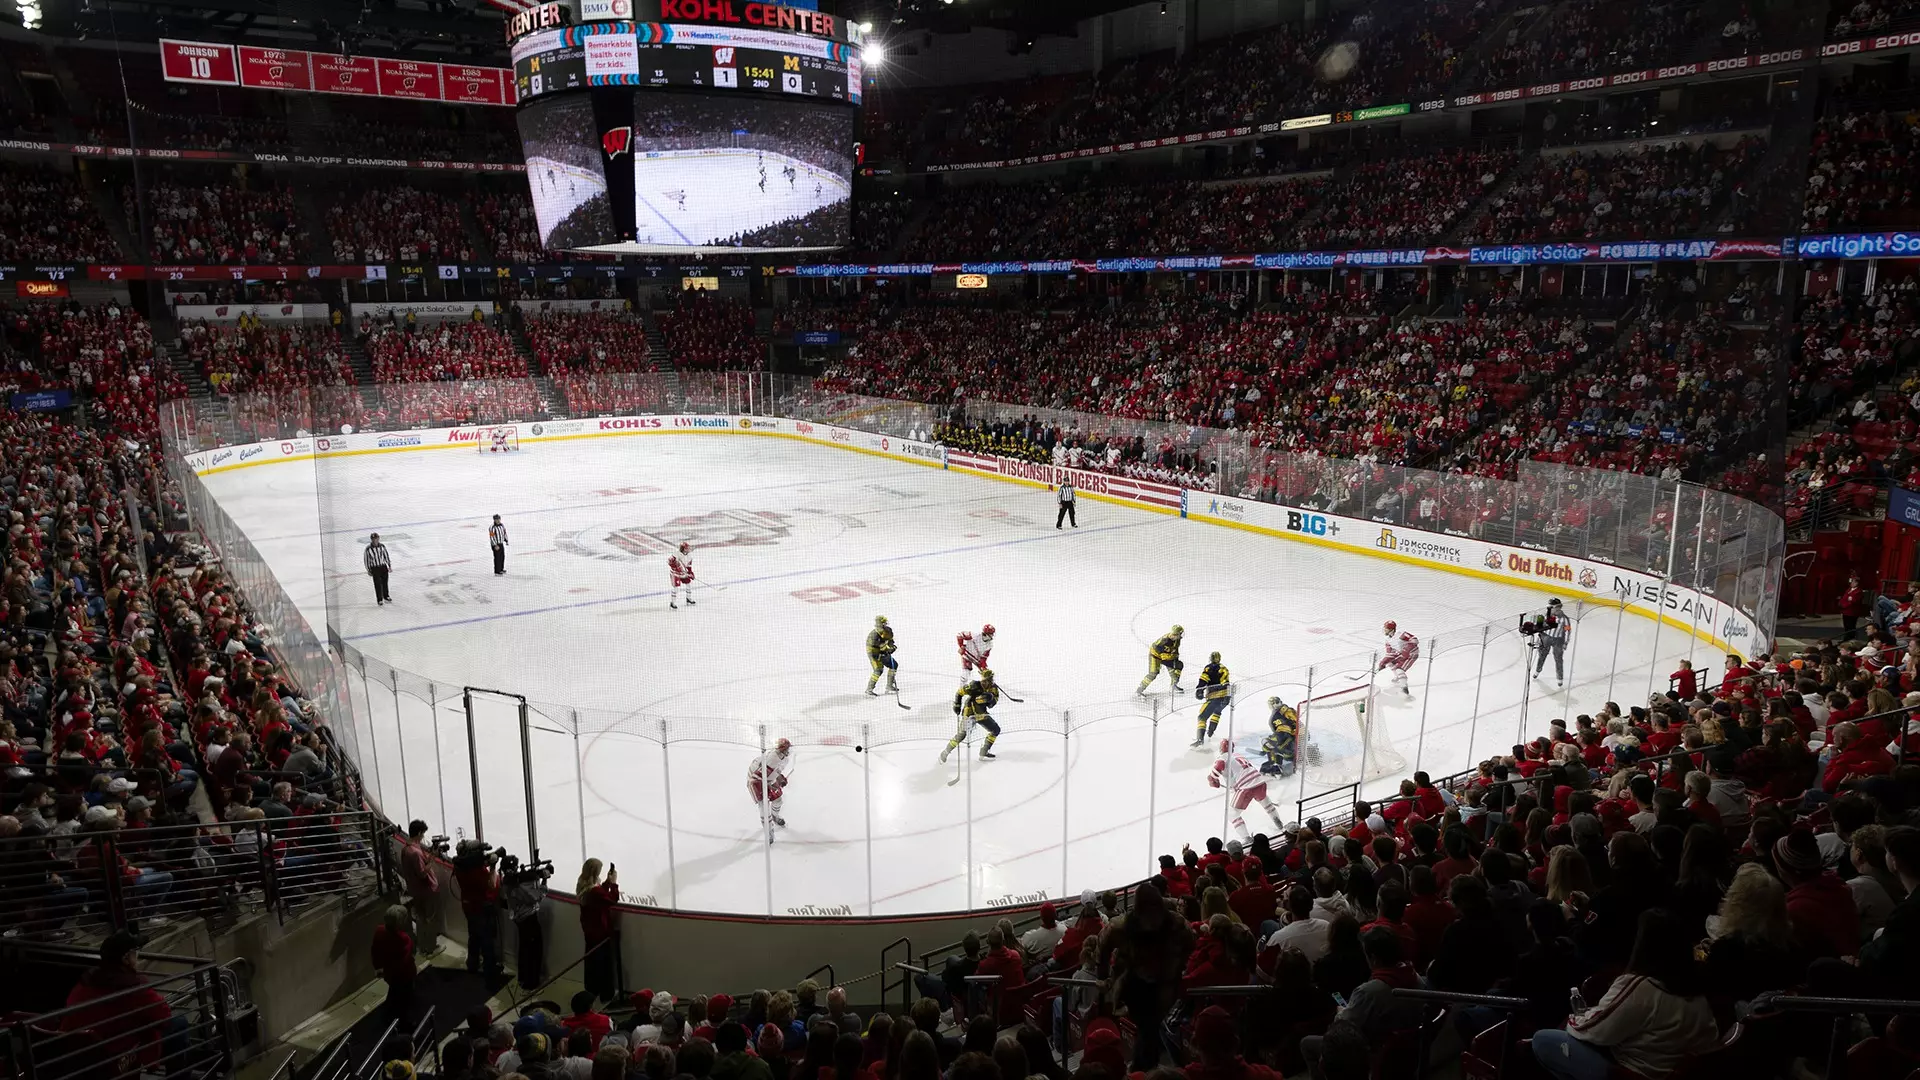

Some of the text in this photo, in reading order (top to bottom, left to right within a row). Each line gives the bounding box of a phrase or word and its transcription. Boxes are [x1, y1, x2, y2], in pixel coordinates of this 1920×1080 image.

[584, 3, 609, 13] BMO
[511, 3, 560, 34] CENTER
[661, 0, 834, 36] KOHL CENTER
[1876, 32, 1920, 49] 2010
[178, 46, 219, 58] JOHNSON
[263, 51, 286, 60] 1973
[1759, 49, 1803, 66] 2006
[190, 57, 212, 79] 10
[320, 63, 370, 73] NCAA Champions
[398, 62, 419, 71] 1981
[1707, 57, 1748, 72] 2005
[406, 70, 433, 79] Champions
[461, 68, 482, 77] 1983
[722, 70, 728, 82] 1
[744, 66, 774, 79] 15:41
[1658, 64, 1697, 78] 2004
[534, 78, 538, 90] 0
[752, 80, 770, 88] 2ND
[788, 76, 796, 88] 0
[1612, 72, 1647, 85] 2001
[1530, 84, 1560, 97] 1998
[1570, 78, 1604, 92] 2000
[1454, 94, 1481, 106] 1994
[1492, 89, 1520, 102] 1995
[1418, 100, 1445, 112] 1993
[1258, 123, 1280, 132] 1992
[75, 145, 102, 155] 1977
[149, 150, 179, 158] 2000
[254, 153, 526, 172] WCHA PLAYOFF CHAMPIONS 1970 1972 1973 197
[926, 164, 949, 172] NCAA
[951, 160, 1004, 170] TOURNAMENT
[1470, 240, 1716, 264] Everlight Solar POWER PLAY
[1783, 234, 1885, 258] Everlight
[1096, 256, 1222, 272] Everlight Solar POWER PLAY
[1254, 250, 1426, 269] Everlight Solar POWER PLAY
[373, 268, 379, 277] 1
[401, 266, 424, 274] 15:41
[445, 268, 453, 277] 0
[796, 264, 934, 277] Everlight Solar POWER PLAY
[962, 260, 1072, 275] Everlight Solar POWER PLAY
[49, 272, 64, 280] 1/3
[108, 272, 116, 280] 4
[170, 272, 184, 280] 20
[232, 272, 243, 280] 13
[281, 272, 286, 280] 1
[26, 283, 58, 294] Quartz
[600, 418, 662, 430] KOHL'S
[831, 428, 850, 441] Quartz
[998, 458, 1108, 494] WISCONSIN BADGERS
[1222, 501, 1244, 512] Alliant
[1222, 510, 1243, 522] Energy
[1400, 538, 1410, 546] JD
[1400, 546, 1460, 562] PROPERTIES
[1508, 553, 1574, 582] Old Dutch
[1613, 576, 1713, 624] NISSAN
